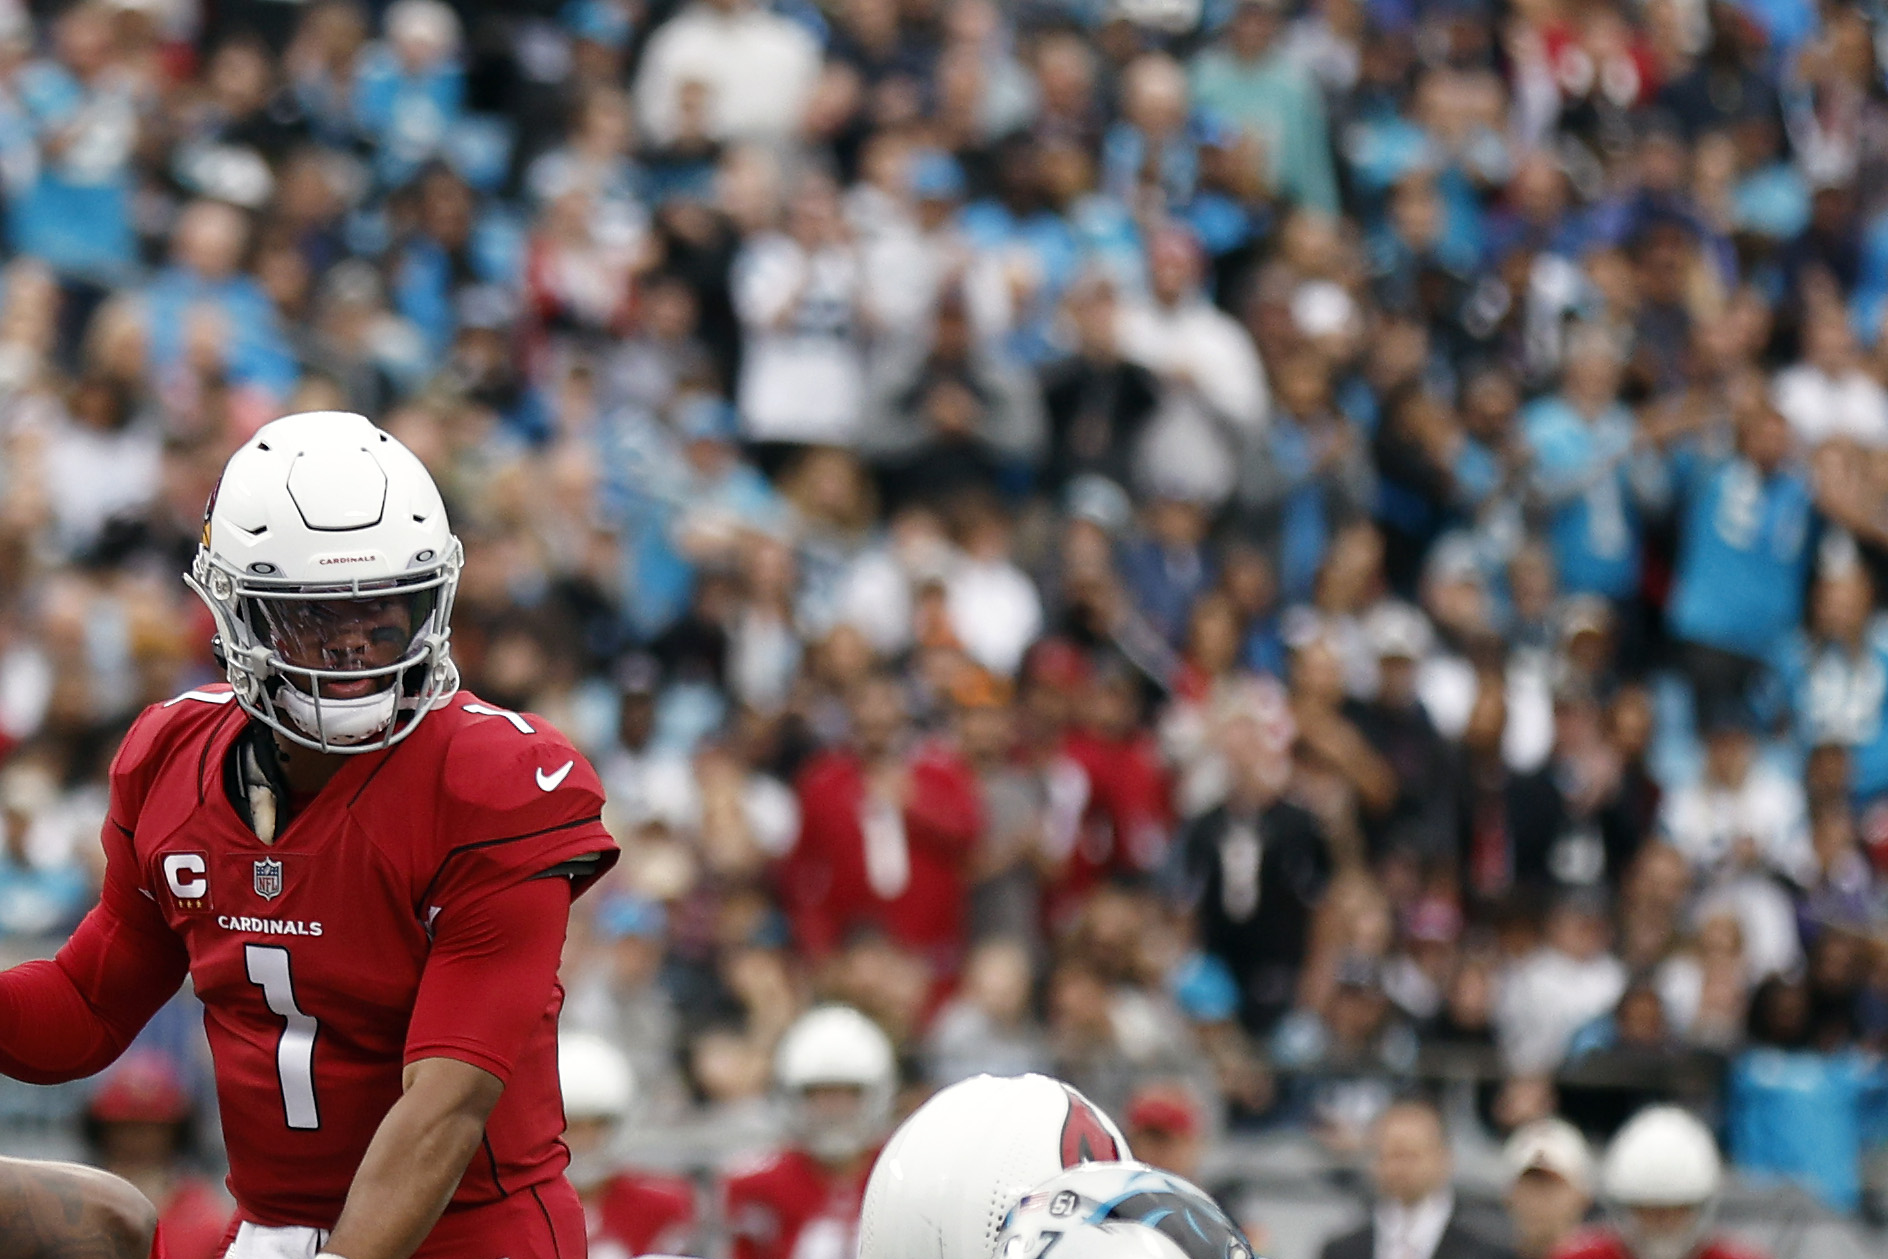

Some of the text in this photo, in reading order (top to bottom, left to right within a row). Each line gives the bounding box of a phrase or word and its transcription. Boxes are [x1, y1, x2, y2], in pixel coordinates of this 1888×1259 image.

[319, 555, 376, 566] CARDINALS
[164, 853, 207, 899] C
[258, 877, 278, 892] NFL
[218, 915, 323, 937] CARDINALS
[244, 943, 320, 1130] 1
